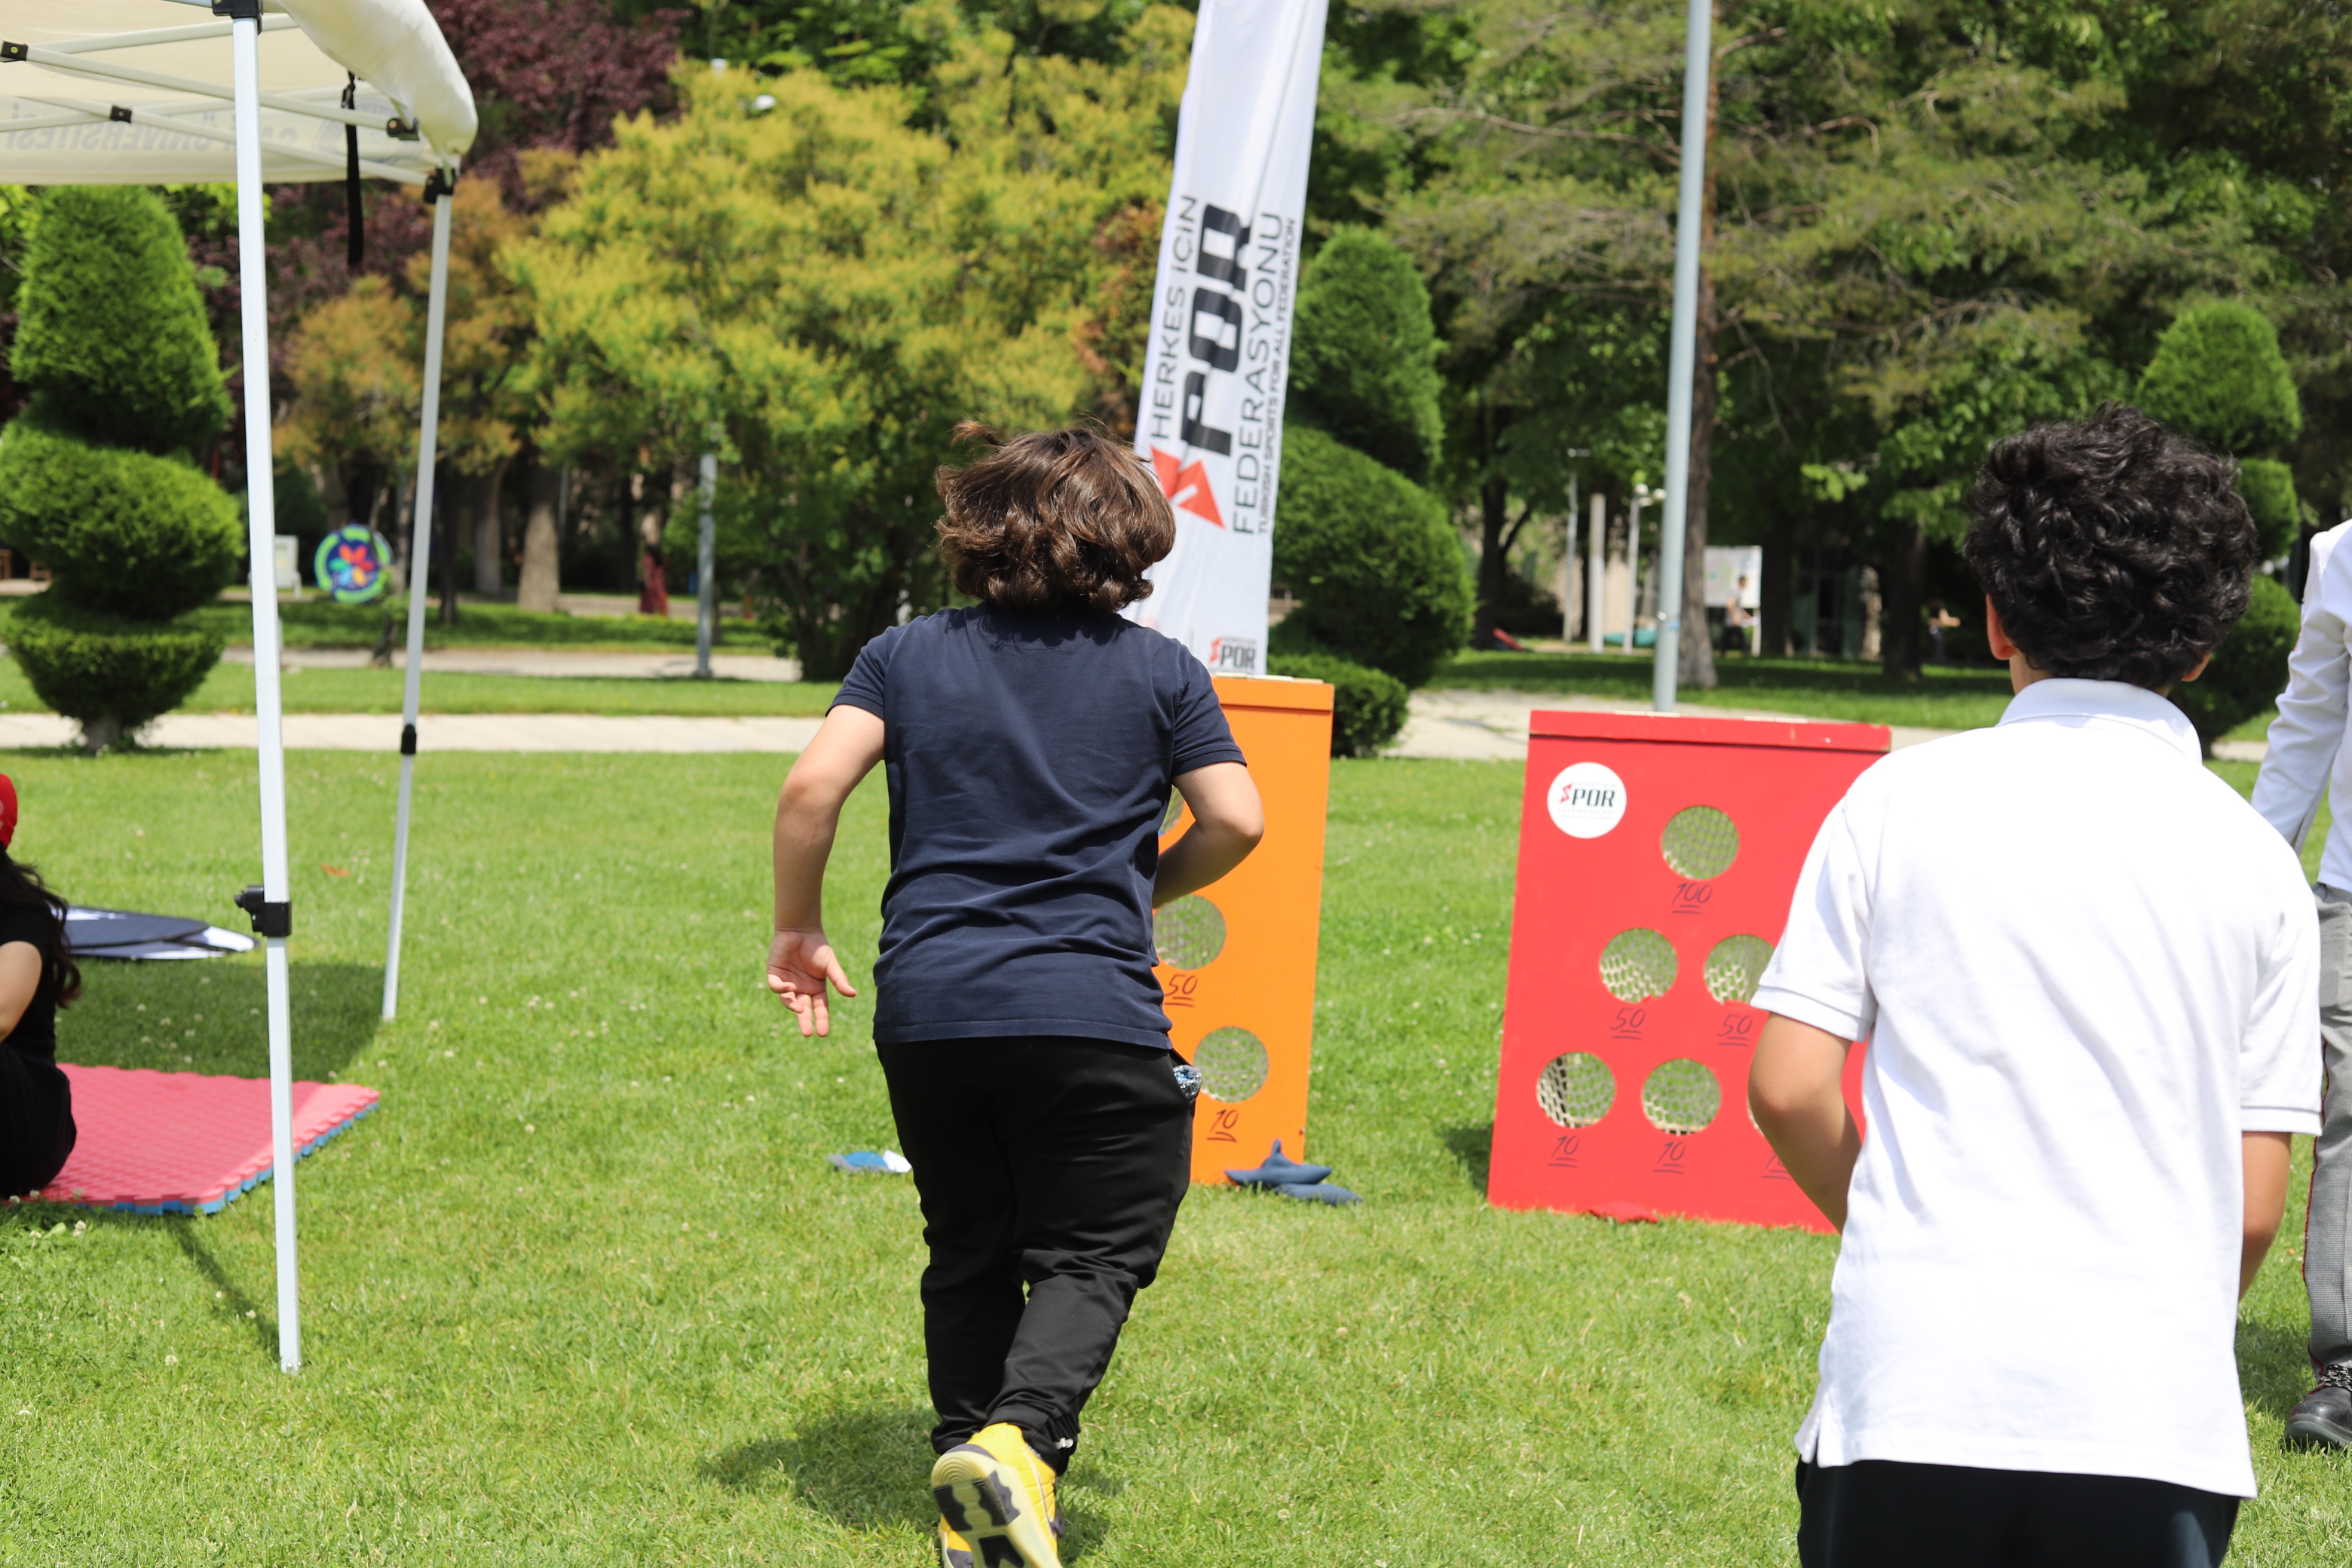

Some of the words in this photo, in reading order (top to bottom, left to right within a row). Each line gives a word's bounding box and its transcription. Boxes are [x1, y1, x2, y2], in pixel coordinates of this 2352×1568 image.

[1276, 218, 1296, 322] FEDERATION
[1273, 326, 1287, 356] ALL
[1151, 286, 1187, 439] HERKES
[1233, 213, 1283, 534] FEDERASYONU
[1269, 359, 1281, 393] FOR
[1264, 396, 1279, 461] SPORTS
[1258, 464, 1272, 535] TURKISH
[1672, 882, 1712, 903] 100
[1164, 973, 1199, 997] 50
[1611, 1008, 1645, 1029] 50
[1717, 1015, 1753, 1035] 50
[1209, 1109, 1239, 1132] 10
[1551, 1135, 1580, 1156] 10
[1658, 1141, 1686, 1162] 10
